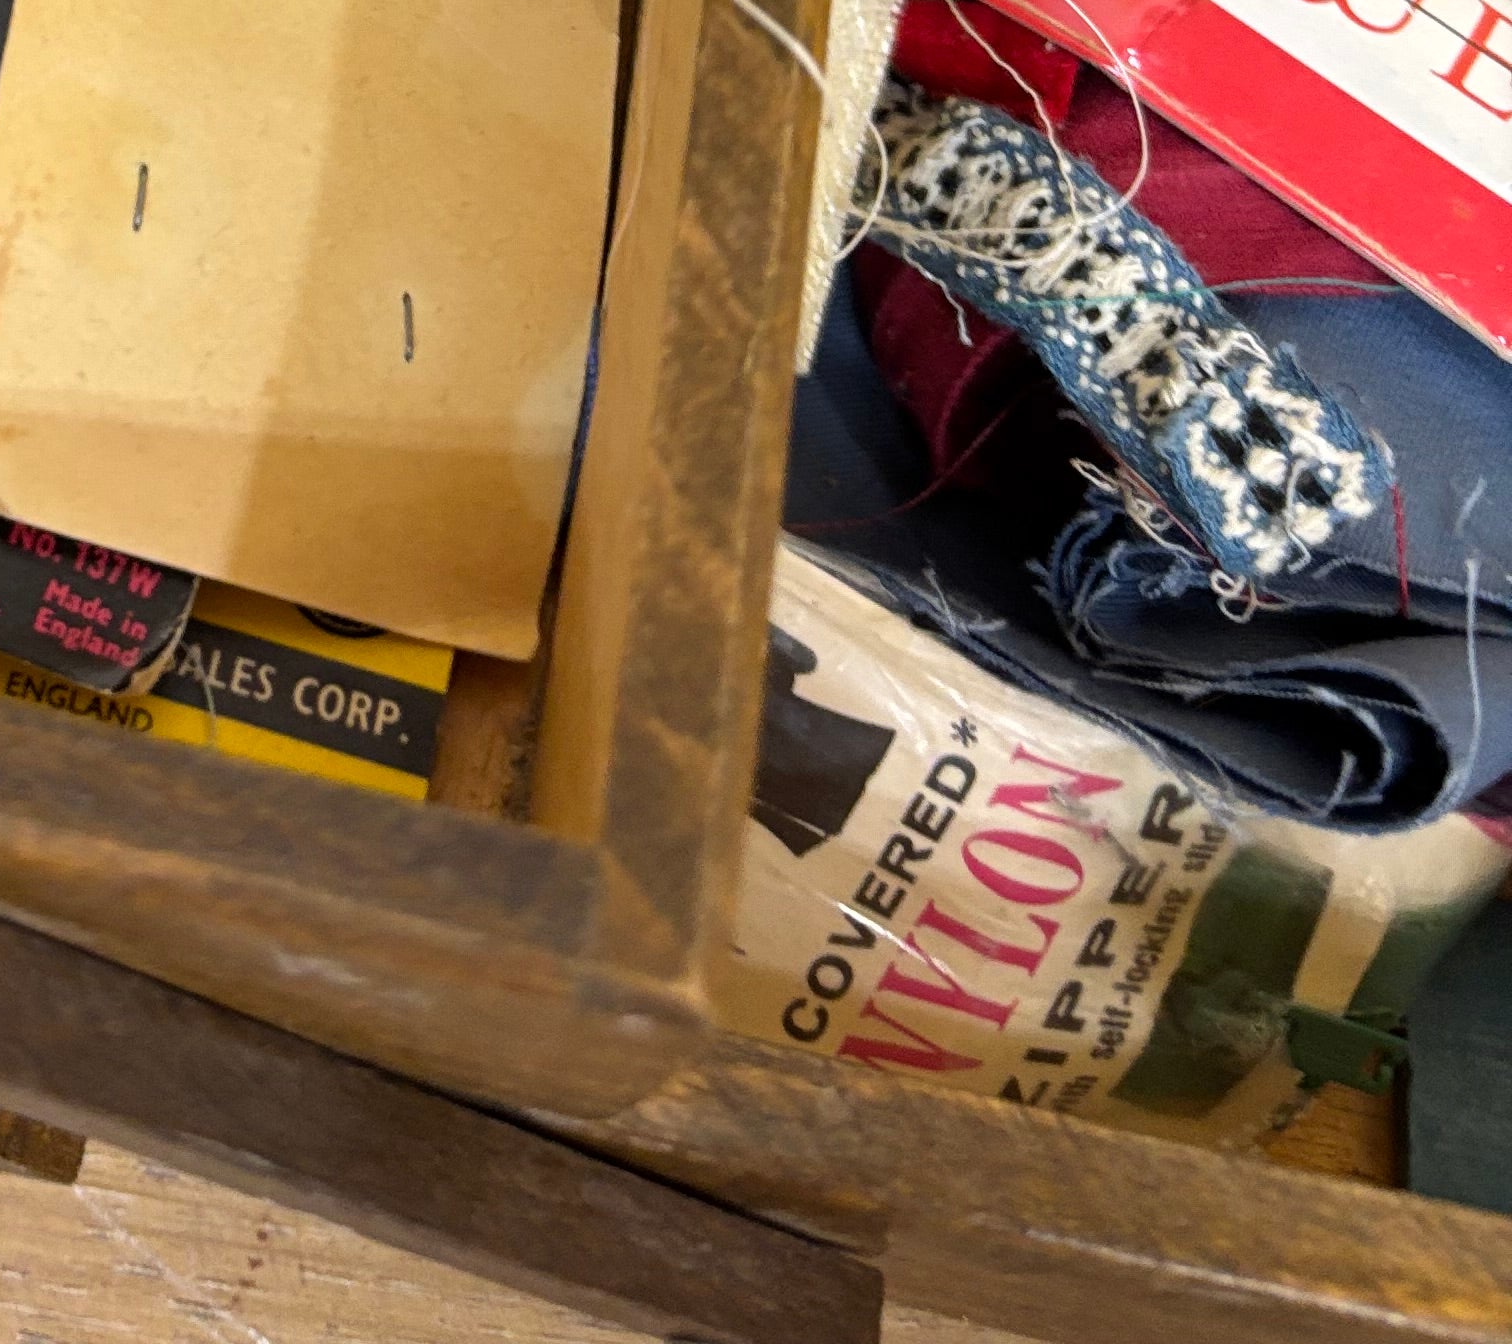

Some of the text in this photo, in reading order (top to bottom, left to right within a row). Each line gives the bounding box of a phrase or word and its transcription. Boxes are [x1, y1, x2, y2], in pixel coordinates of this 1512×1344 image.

[72, 537, 164, 601] 137W
[30, 605, 144, 671] England
[41, 577, 151, 644] Made in
[3, 669, 157, 736] ENGLAND
[168, 642, 412, 746] ALES CORP.
